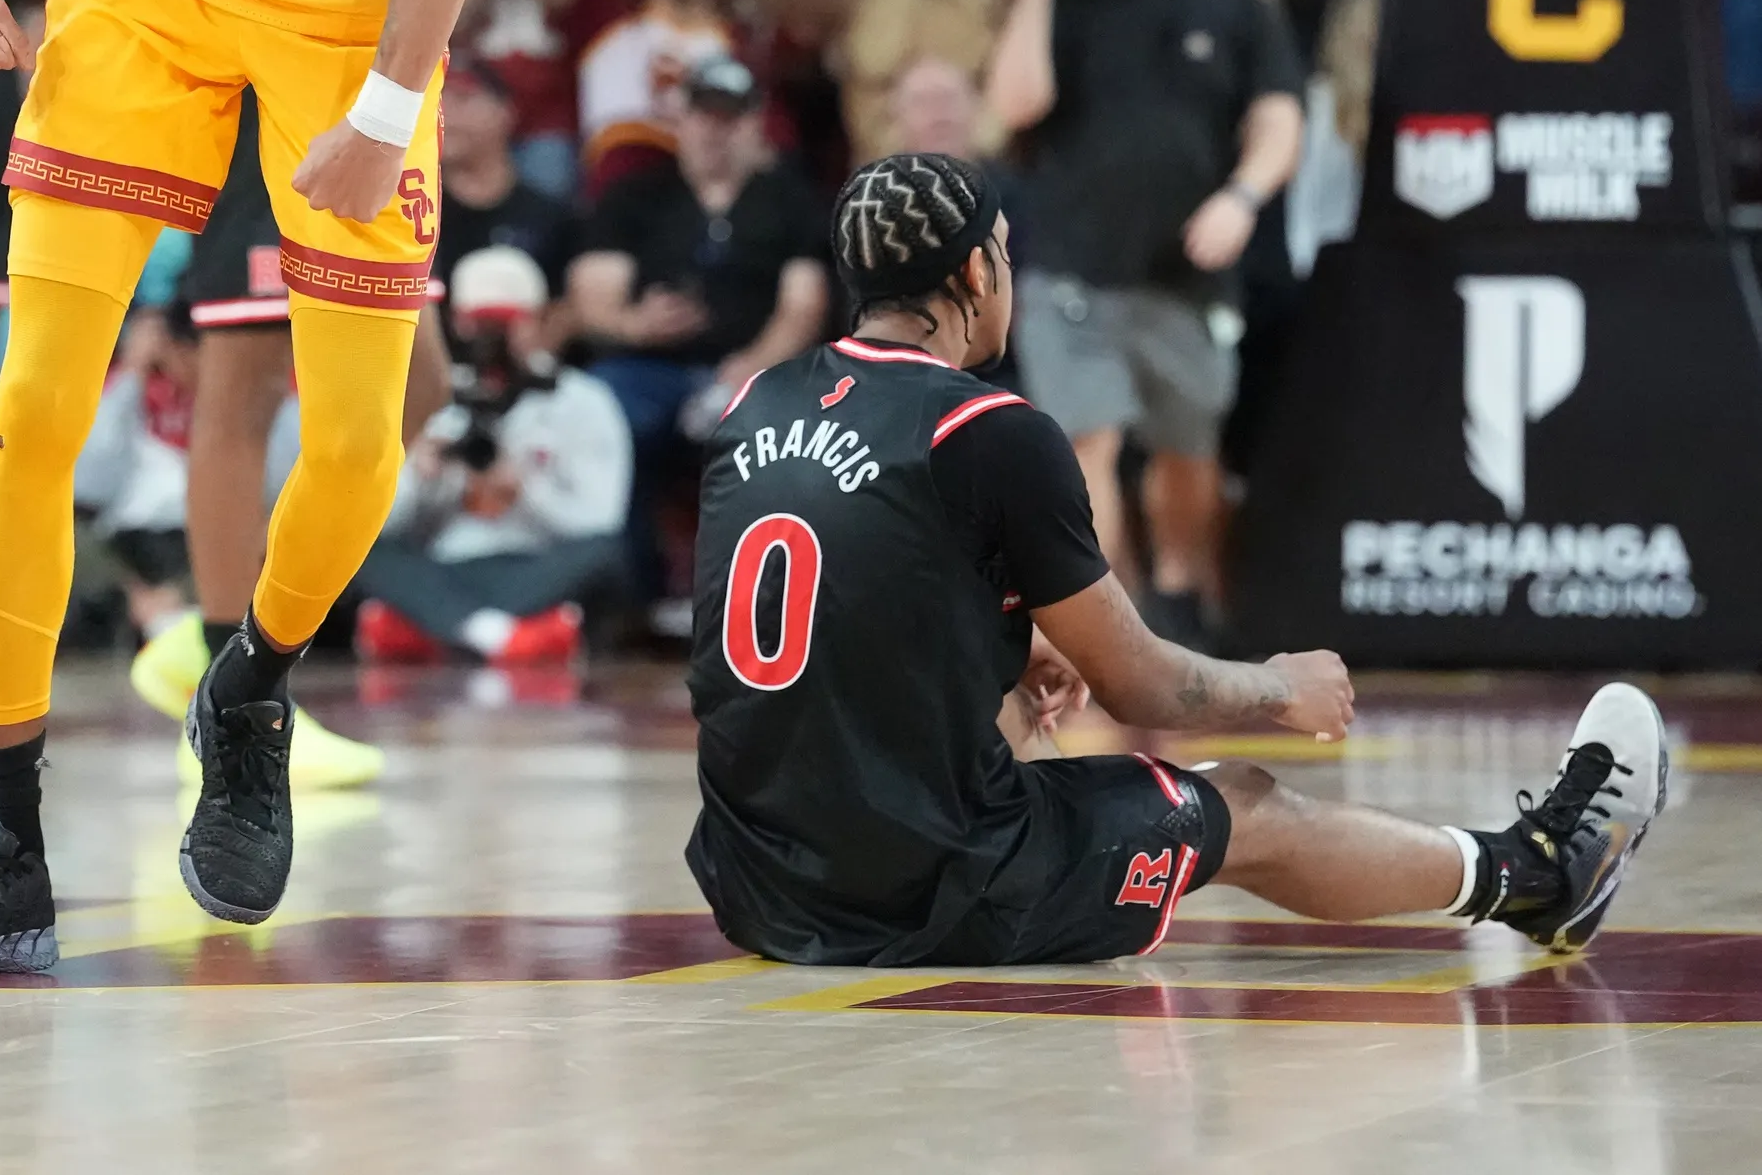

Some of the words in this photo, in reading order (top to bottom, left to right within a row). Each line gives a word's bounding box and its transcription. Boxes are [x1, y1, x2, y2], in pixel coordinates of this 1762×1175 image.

[1496, 111, 1673, 173] MUSCLE
[398, 168, 435, 245] SC
[1526, 168, 1641, 222] MILK
[733, 419, 880, 493] FRANCIS
[1341, 520, 1691, 580] PECHANGA
[722, 513, 822, 691] 0
[1341, 578, 1509, 616] RESORT
[1115, 848, 1172, 908] R
